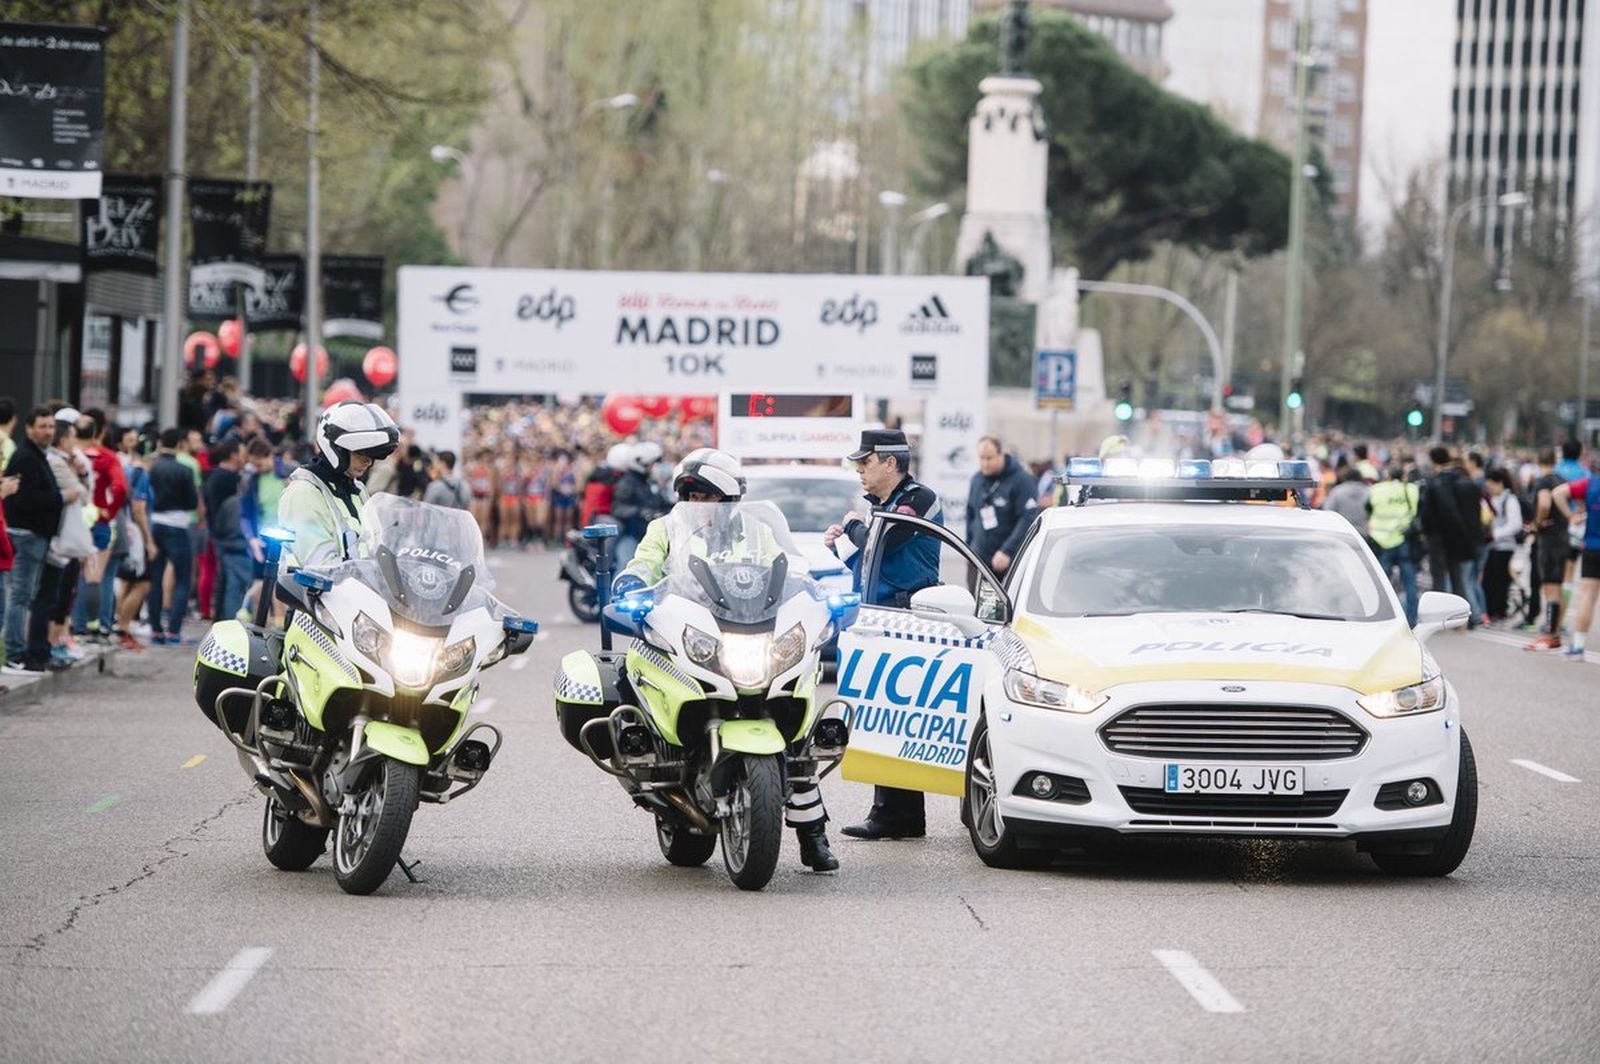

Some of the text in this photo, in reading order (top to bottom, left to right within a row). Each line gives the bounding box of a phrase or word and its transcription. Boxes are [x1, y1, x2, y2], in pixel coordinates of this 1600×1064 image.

[516, 289, 576, 329] edp
[820, 293, 879, 333] edp
[616, 316, 780, 346] MADRID
[665, 354, 724, 375] 10K
[397, 547, 461, 569] POLICIA
[837, 648, 973, 714] LICÍA
[843, 704, 969, 745] MUNICIPAL
[898, 741, 966, 765] MADRID
[1183, 768, 1297, 791] 3004 JVG
